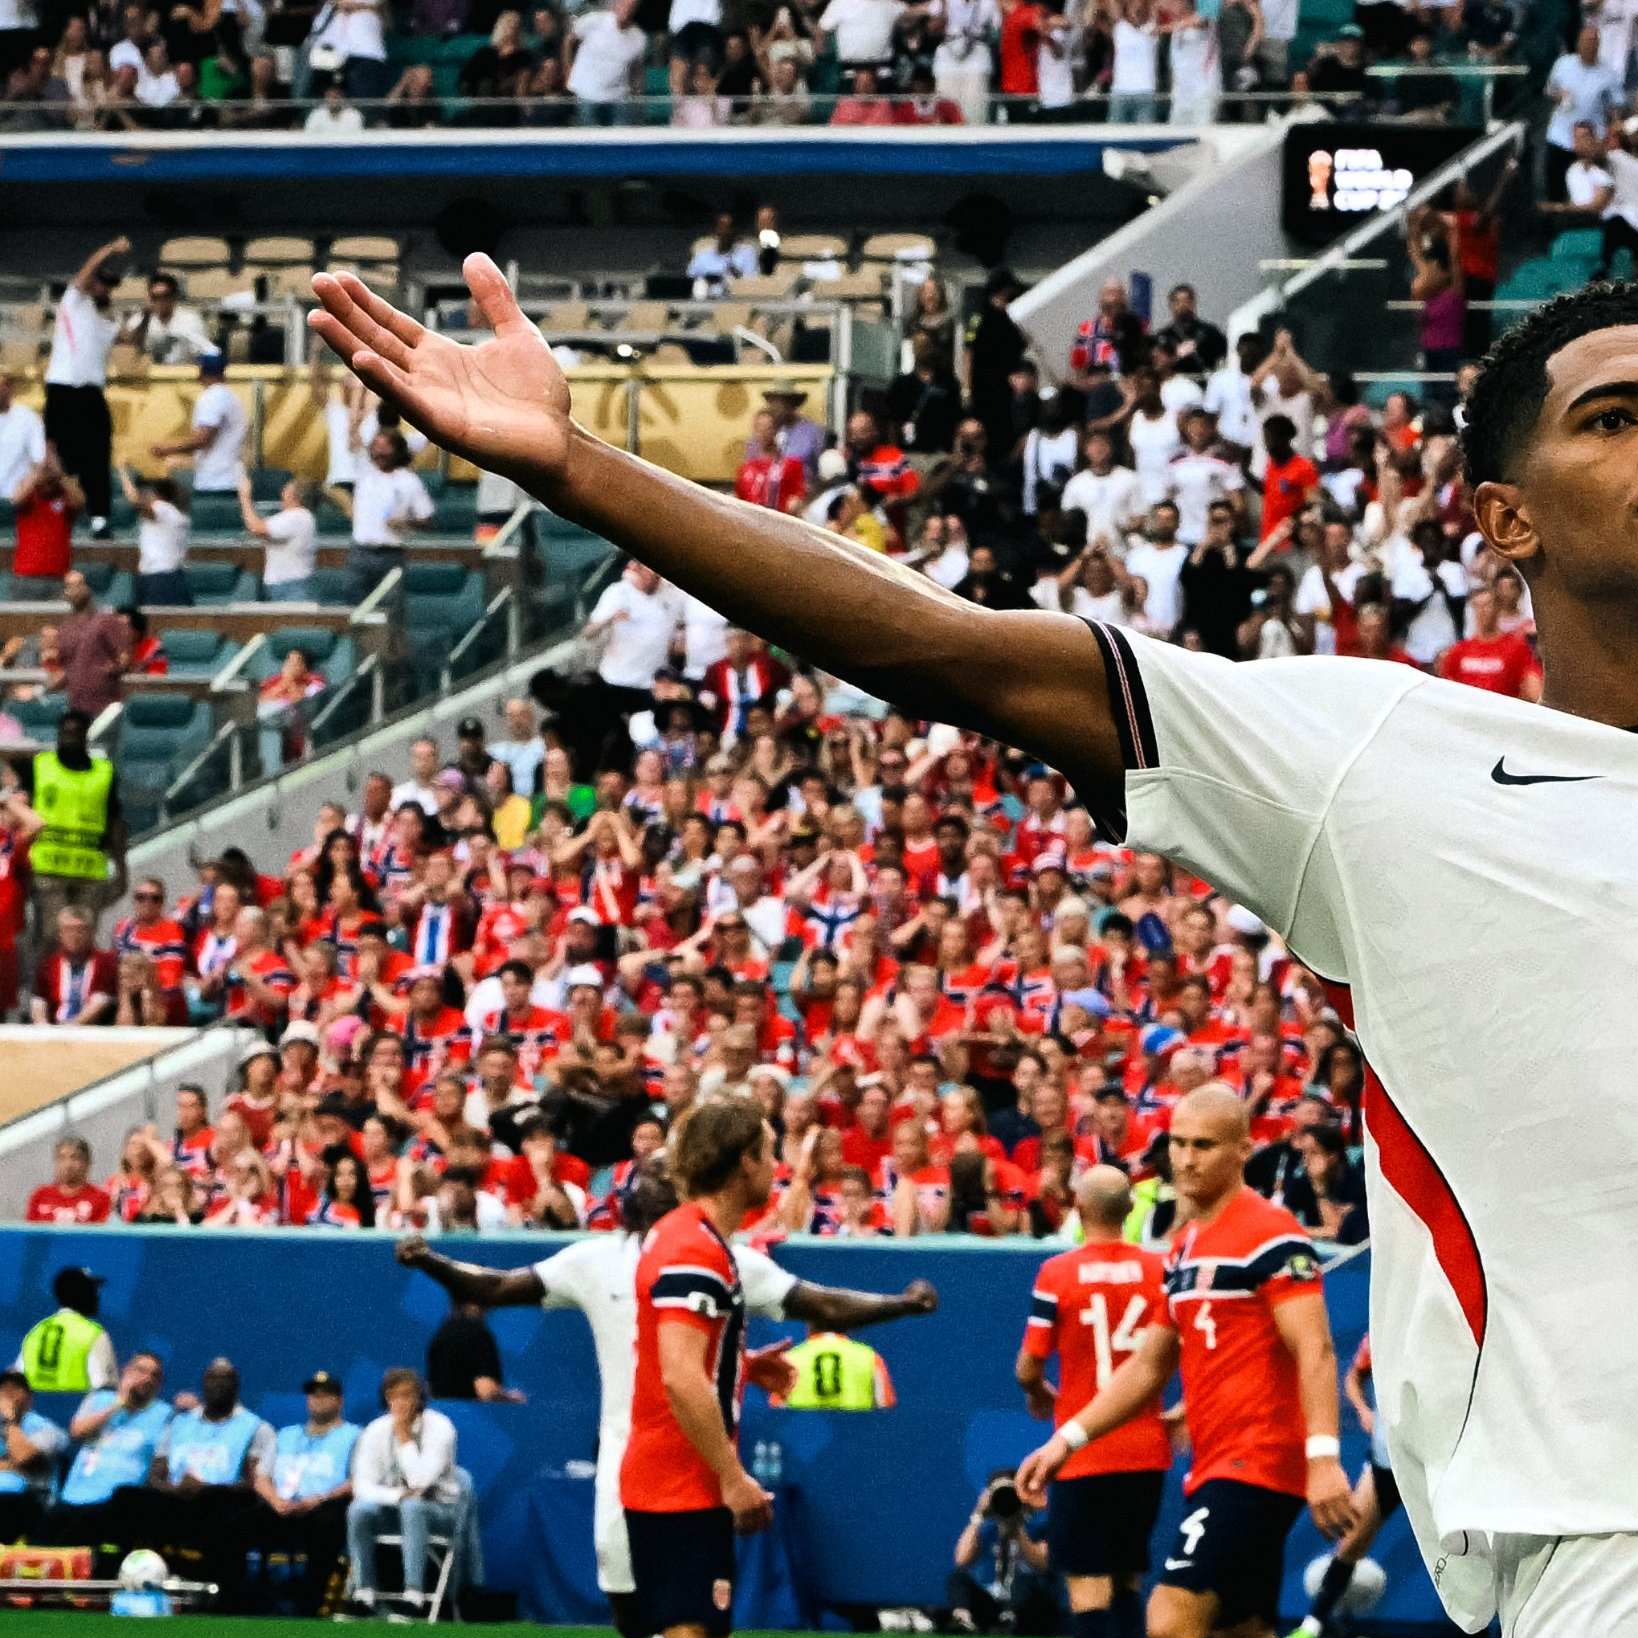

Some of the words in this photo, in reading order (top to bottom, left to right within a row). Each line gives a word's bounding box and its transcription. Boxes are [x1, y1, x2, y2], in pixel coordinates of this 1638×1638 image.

[1079, 1292, 1149, 1392] 14
[1193, 1300, 1217, 1350] 4
[1180, 1506, 1210, 1555] 4
